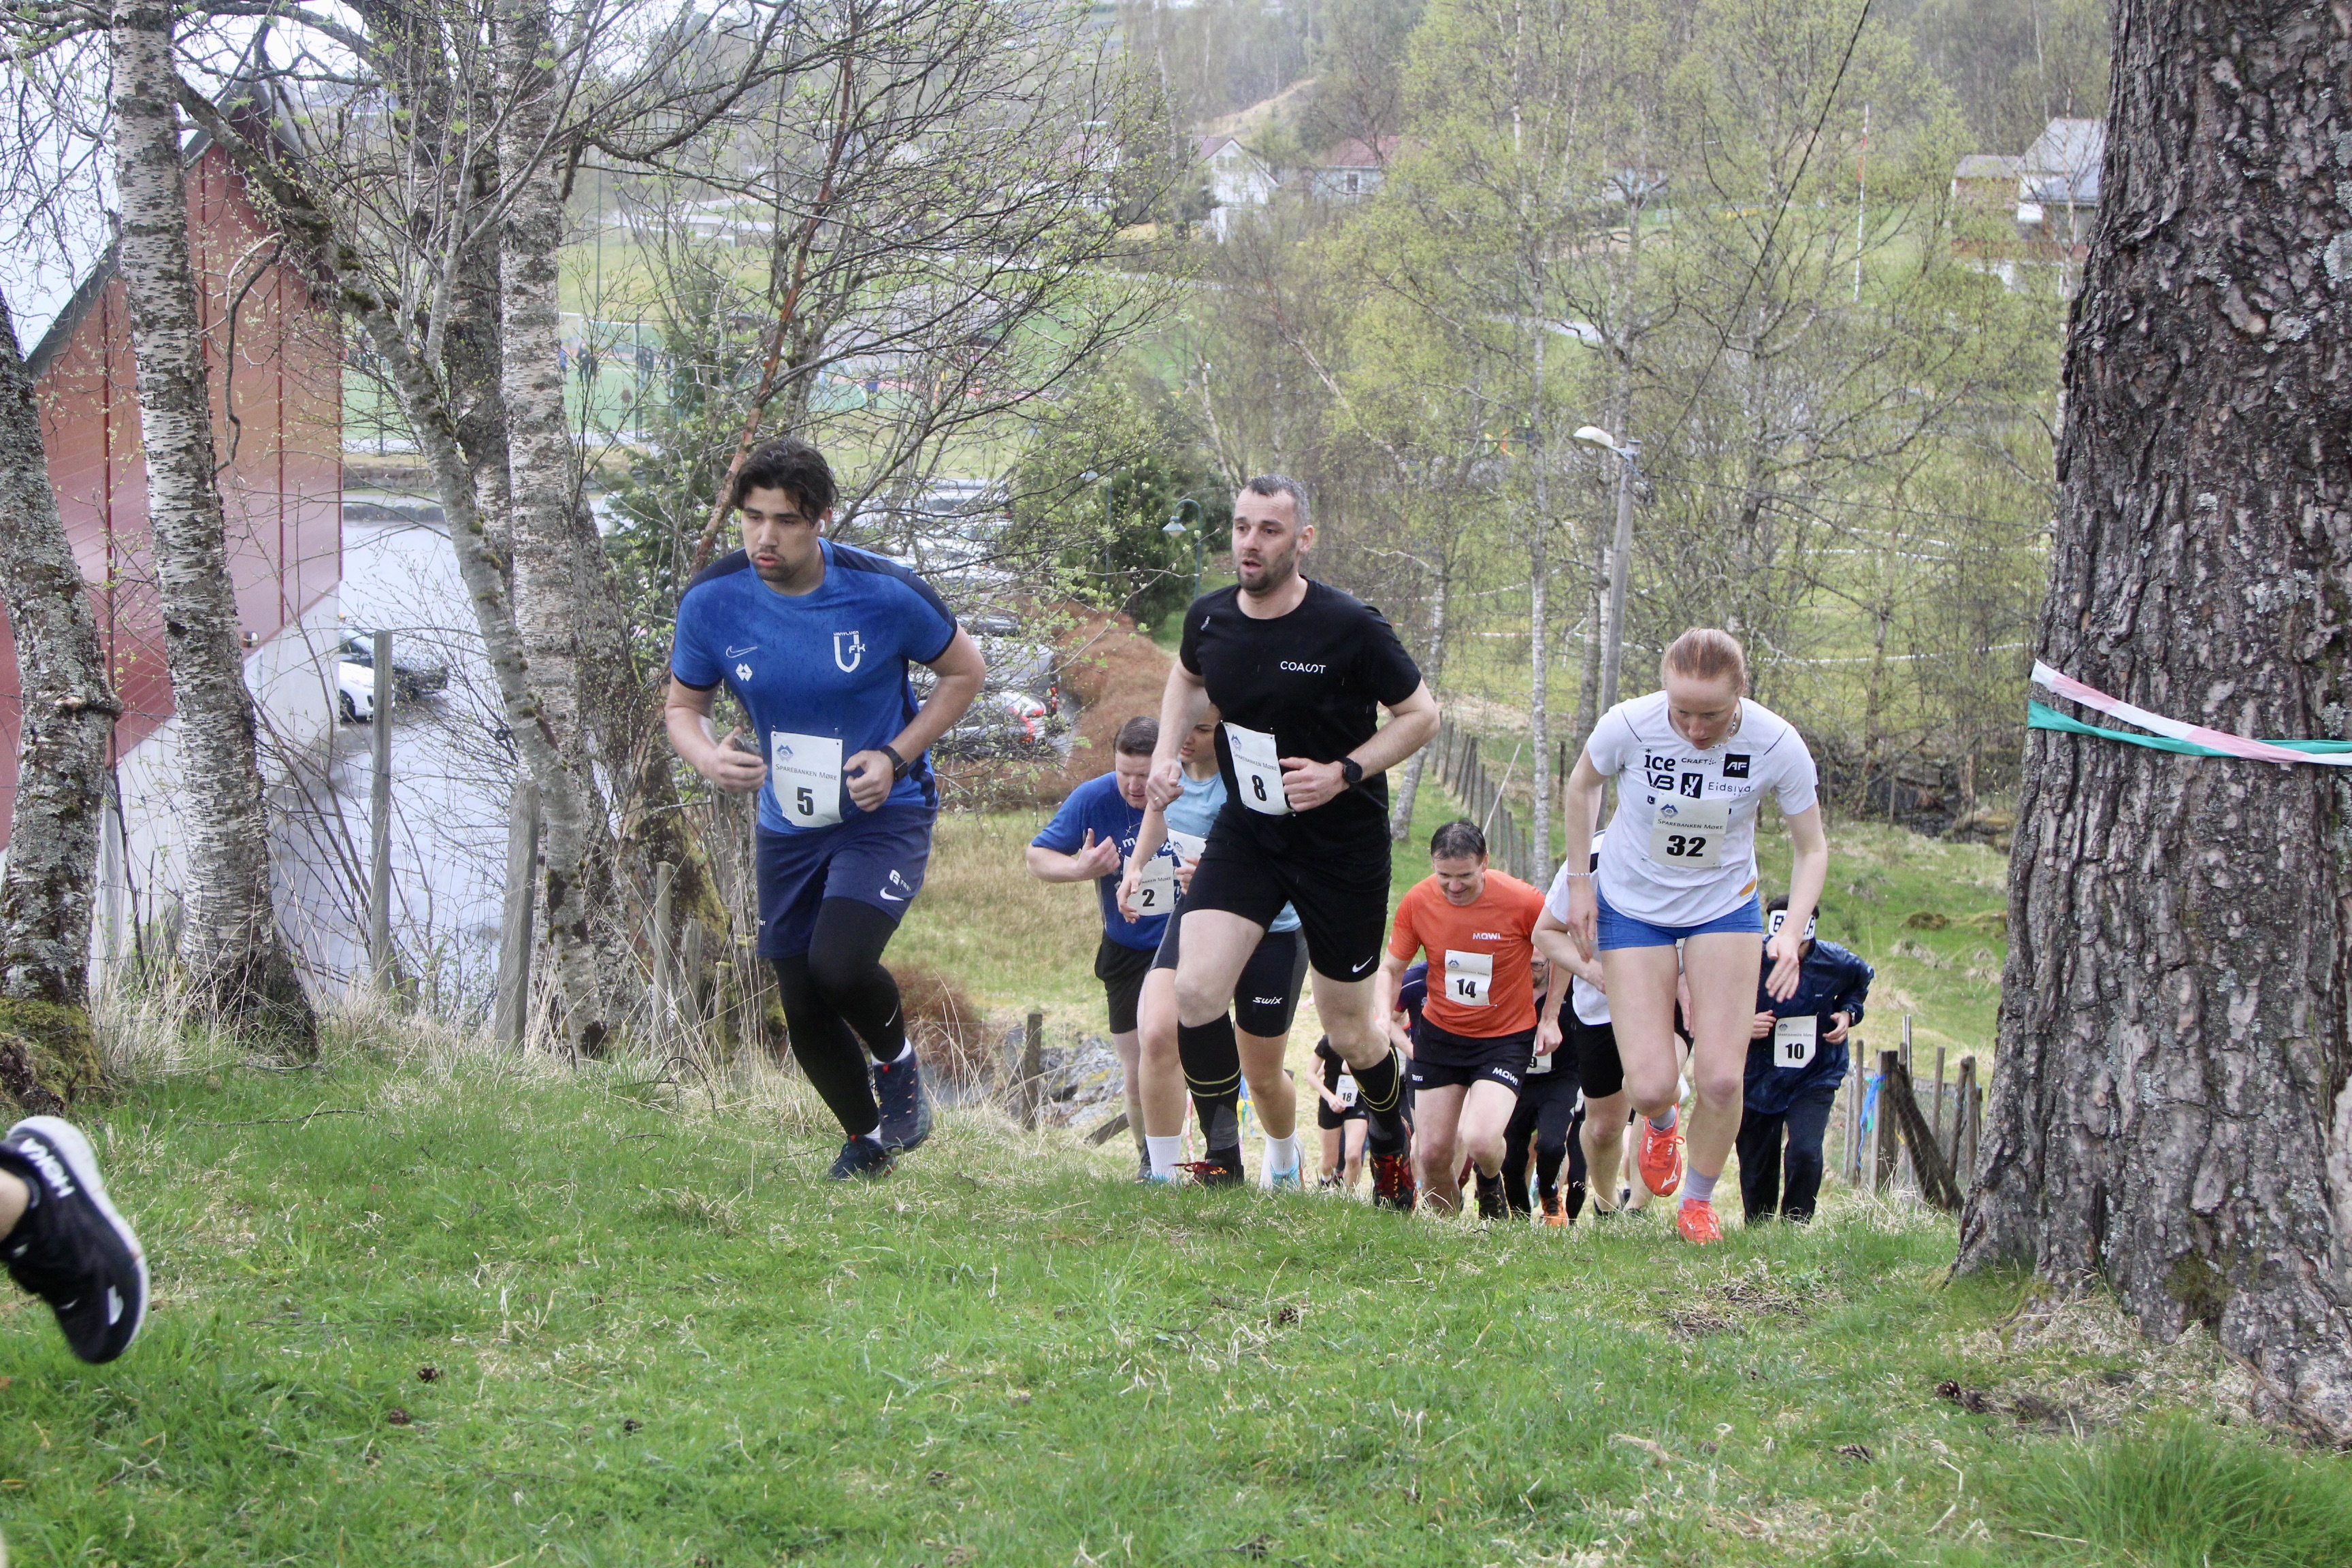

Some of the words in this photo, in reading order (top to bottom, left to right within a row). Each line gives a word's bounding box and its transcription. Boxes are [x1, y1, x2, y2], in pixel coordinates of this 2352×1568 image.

[1280, 661, 1326, 674] COAST
[1644, 748, 1676, 771] ice
[776, 764, 817, 777] SPAREBANKEN
[819, 772, 838, 781] MØRE
[1252, 774, 1267, 802] 8
[1708, 783, 1752, 792] Eidsiva
[797, 786, 814, 816] 5
[1657, 819, 1701, 828] SPAREBANKEN
[1666, 834, 1706, 857] 32
[1142, 889, 1155, 907] 2
[1456, 978, 1476, 998] 14
[1785, 1043, 1804, 1059] 10
[1492, 1066, 1518, 1085] MOWI
[1342, 1092, 1352, 1102] 18
